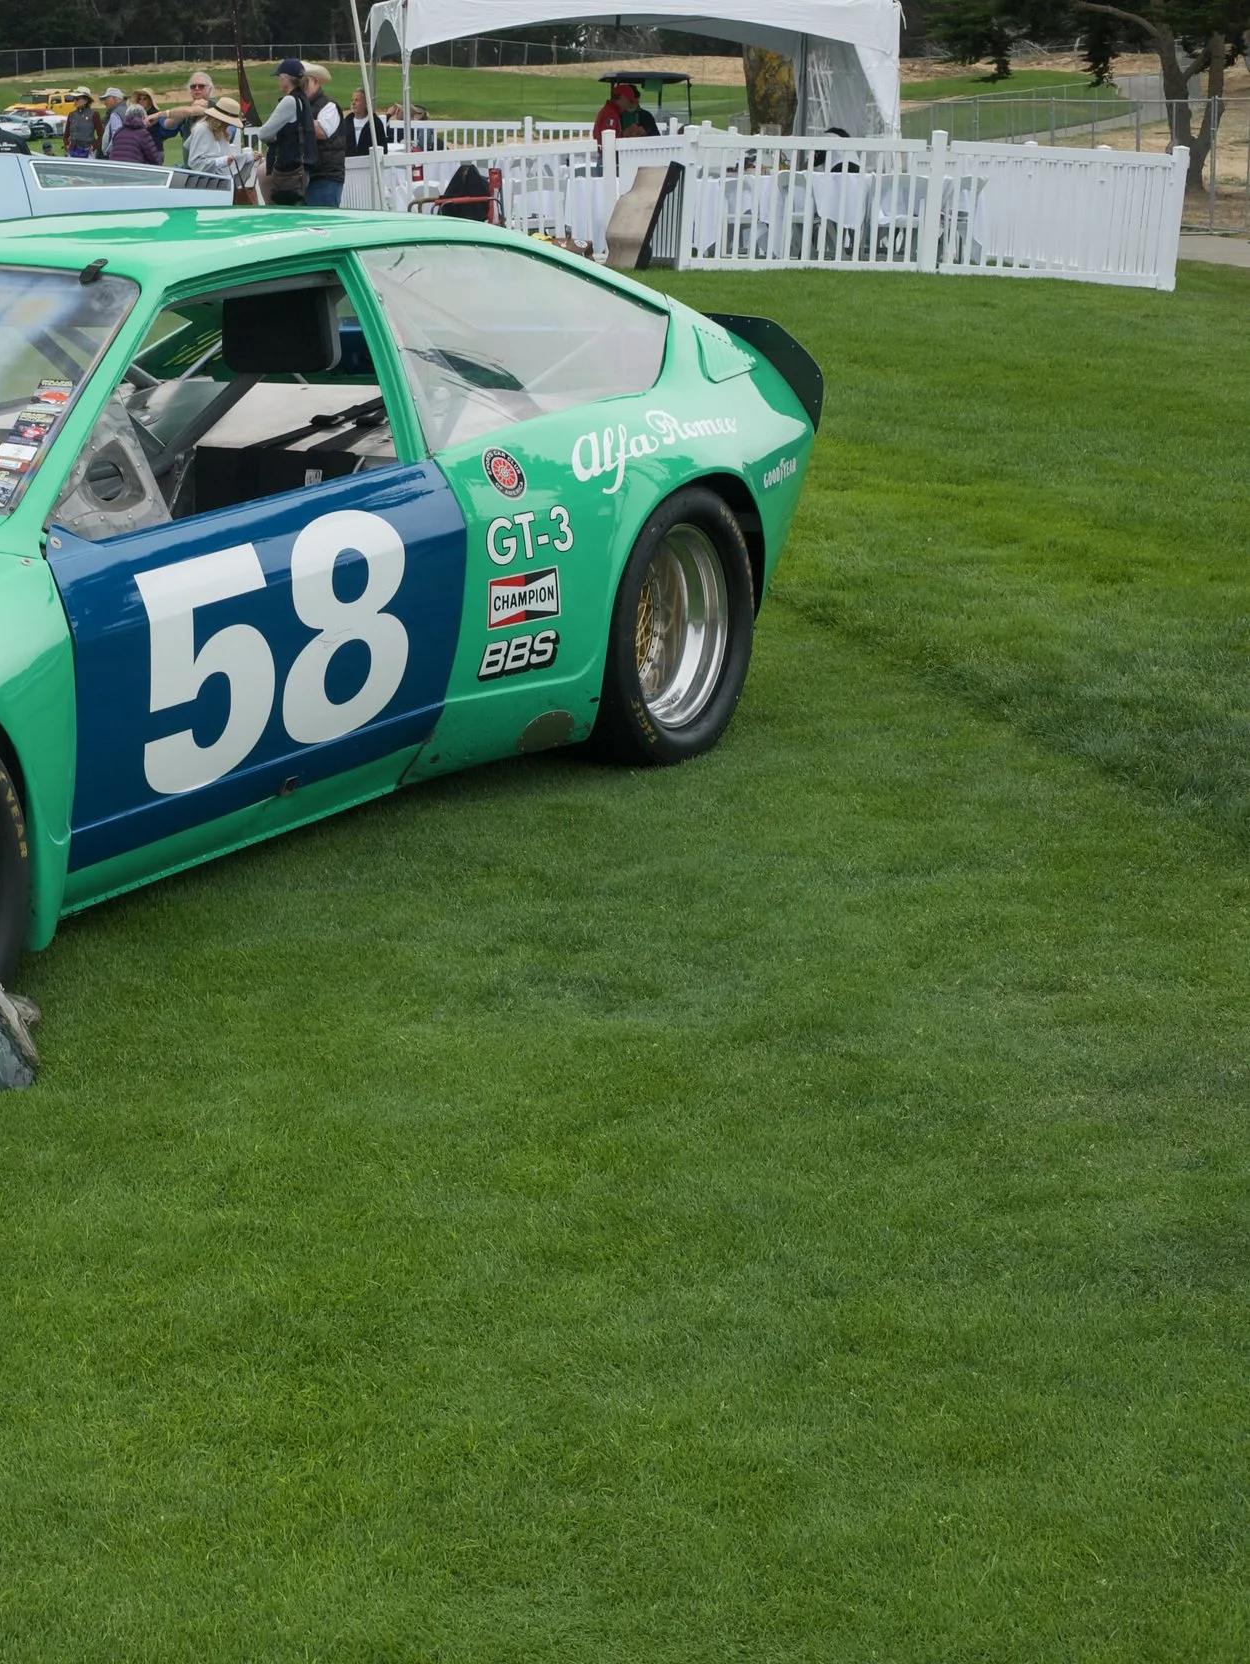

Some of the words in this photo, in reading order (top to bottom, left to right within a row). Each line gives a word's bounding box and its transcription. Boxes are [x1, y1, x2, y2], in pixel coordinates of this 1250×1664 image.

[493, 450, 506, 458] CAR
[506, 456, 521, 475] CLUB
[571, 423, 660, 495] Alfa
[645, 409, 738, 445] Romeo
[763, 456, 798, 489] GOODYEAR
[486, 504, 575, 566] GT-3
[493, 584, 555, 612] CHAMPION
[133, 509, 410, 795] 58
[477, 629, 559, 681] BBS
